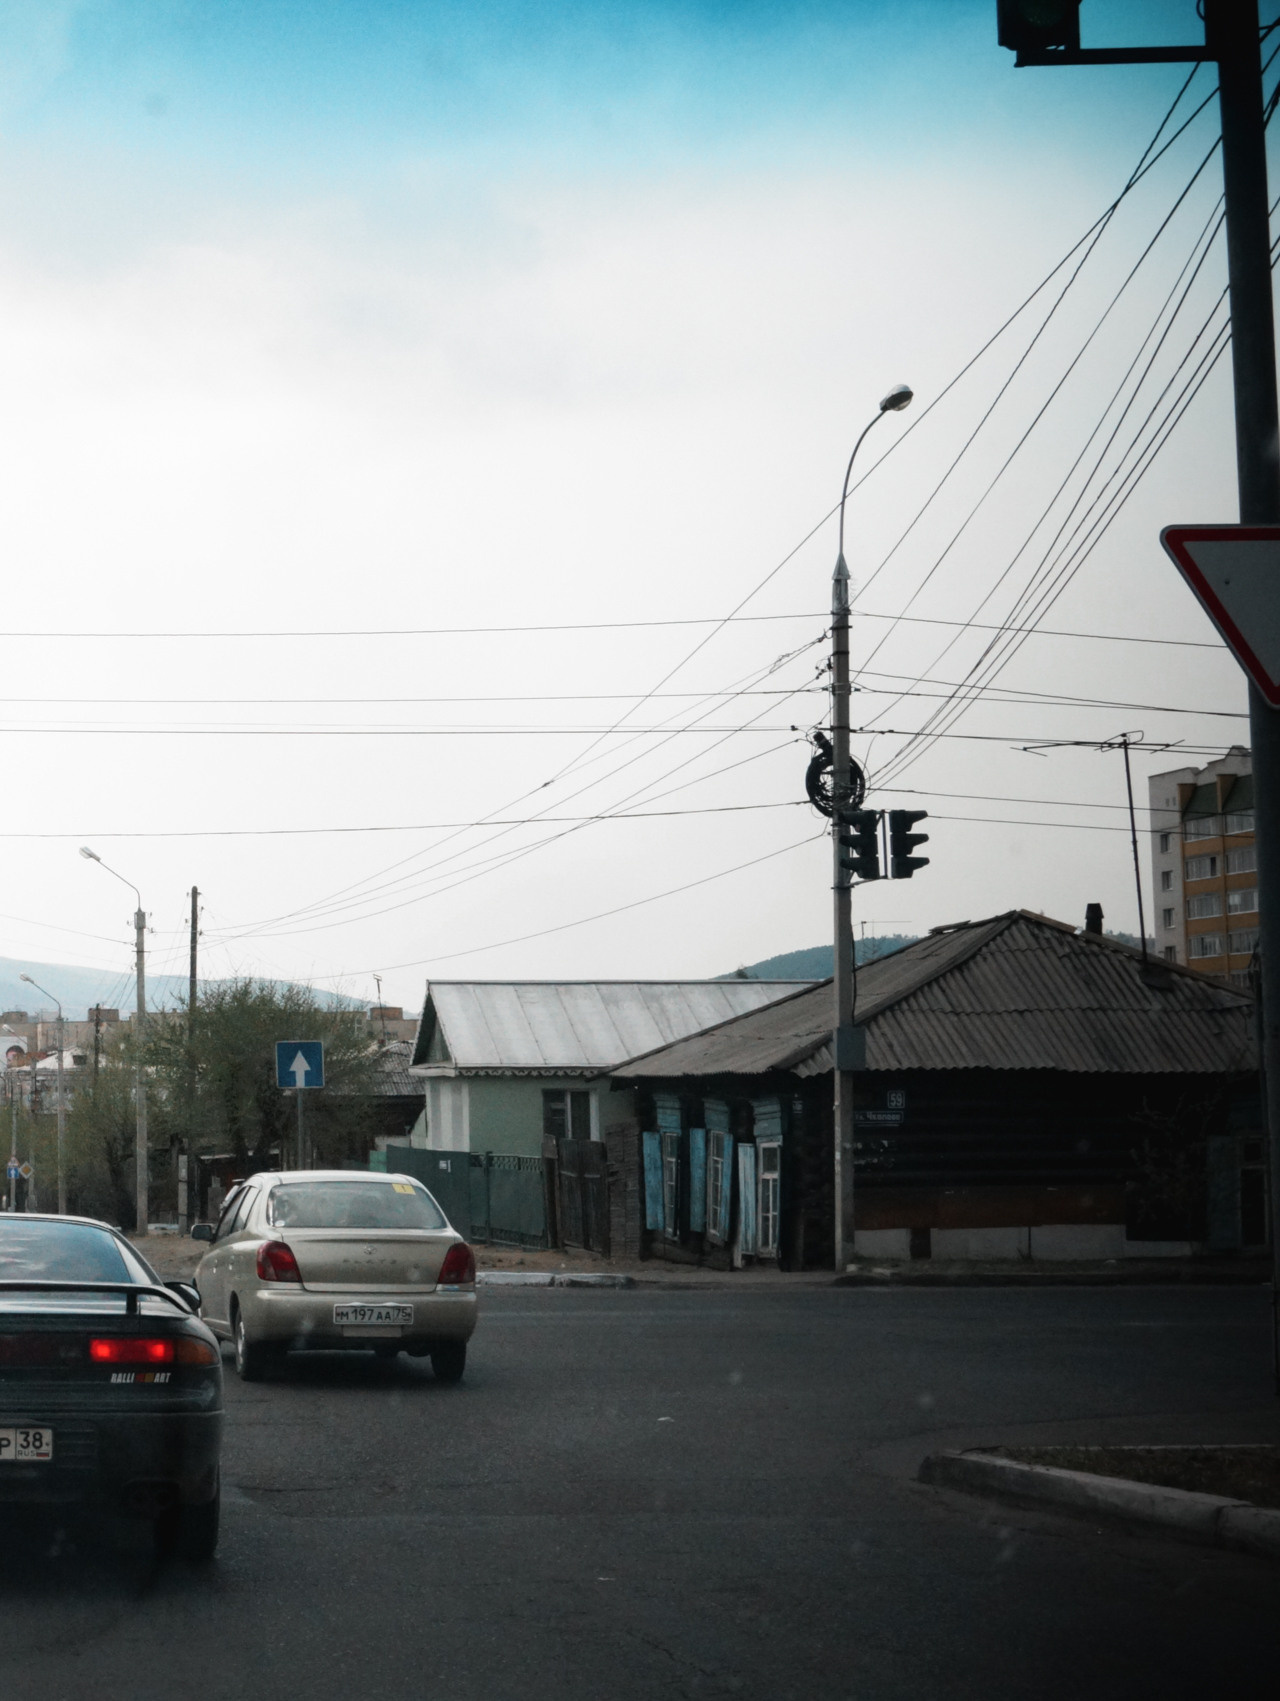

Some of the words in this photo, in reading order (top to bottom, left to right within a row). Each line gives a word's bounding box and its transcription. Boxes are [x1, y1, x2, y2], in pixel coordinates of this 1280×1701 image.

[890, 1093, 903, 1106] 59
[394, 1308, 408, 1318] 75
[110, 1372, 135, 1384] RALLI
[153, 1372, 172, 1383] ART
[19, 1431, 43, 1450] 38
